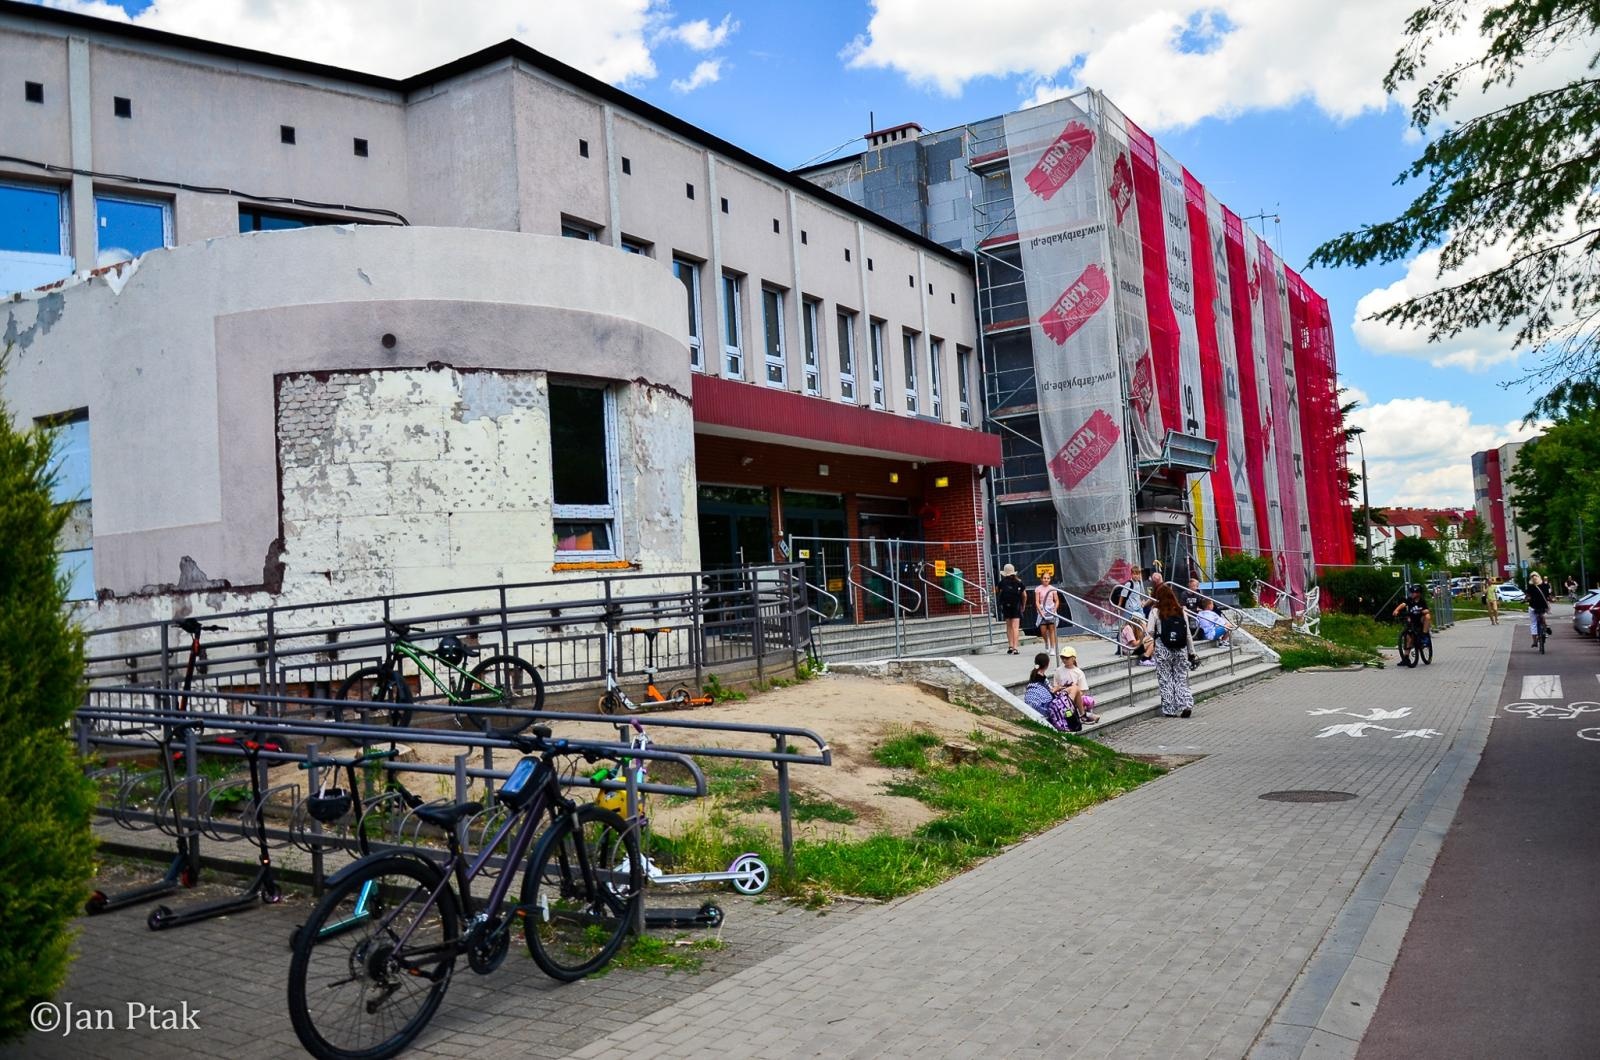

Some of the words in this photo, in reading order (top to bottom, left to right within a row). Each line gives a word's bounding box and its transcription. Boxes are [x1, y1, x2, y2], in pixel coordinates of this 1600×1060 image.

[1039, 139, 1072, 175] KABE
[1048, 145, 1087, 186] Farby
[1055, 281, 1089, 319] KABE
[1063, 289, 1105, 331] Farby
[1061, 427, 1096, 465] KABE
[1070, 433, 1112, 479] Farby
